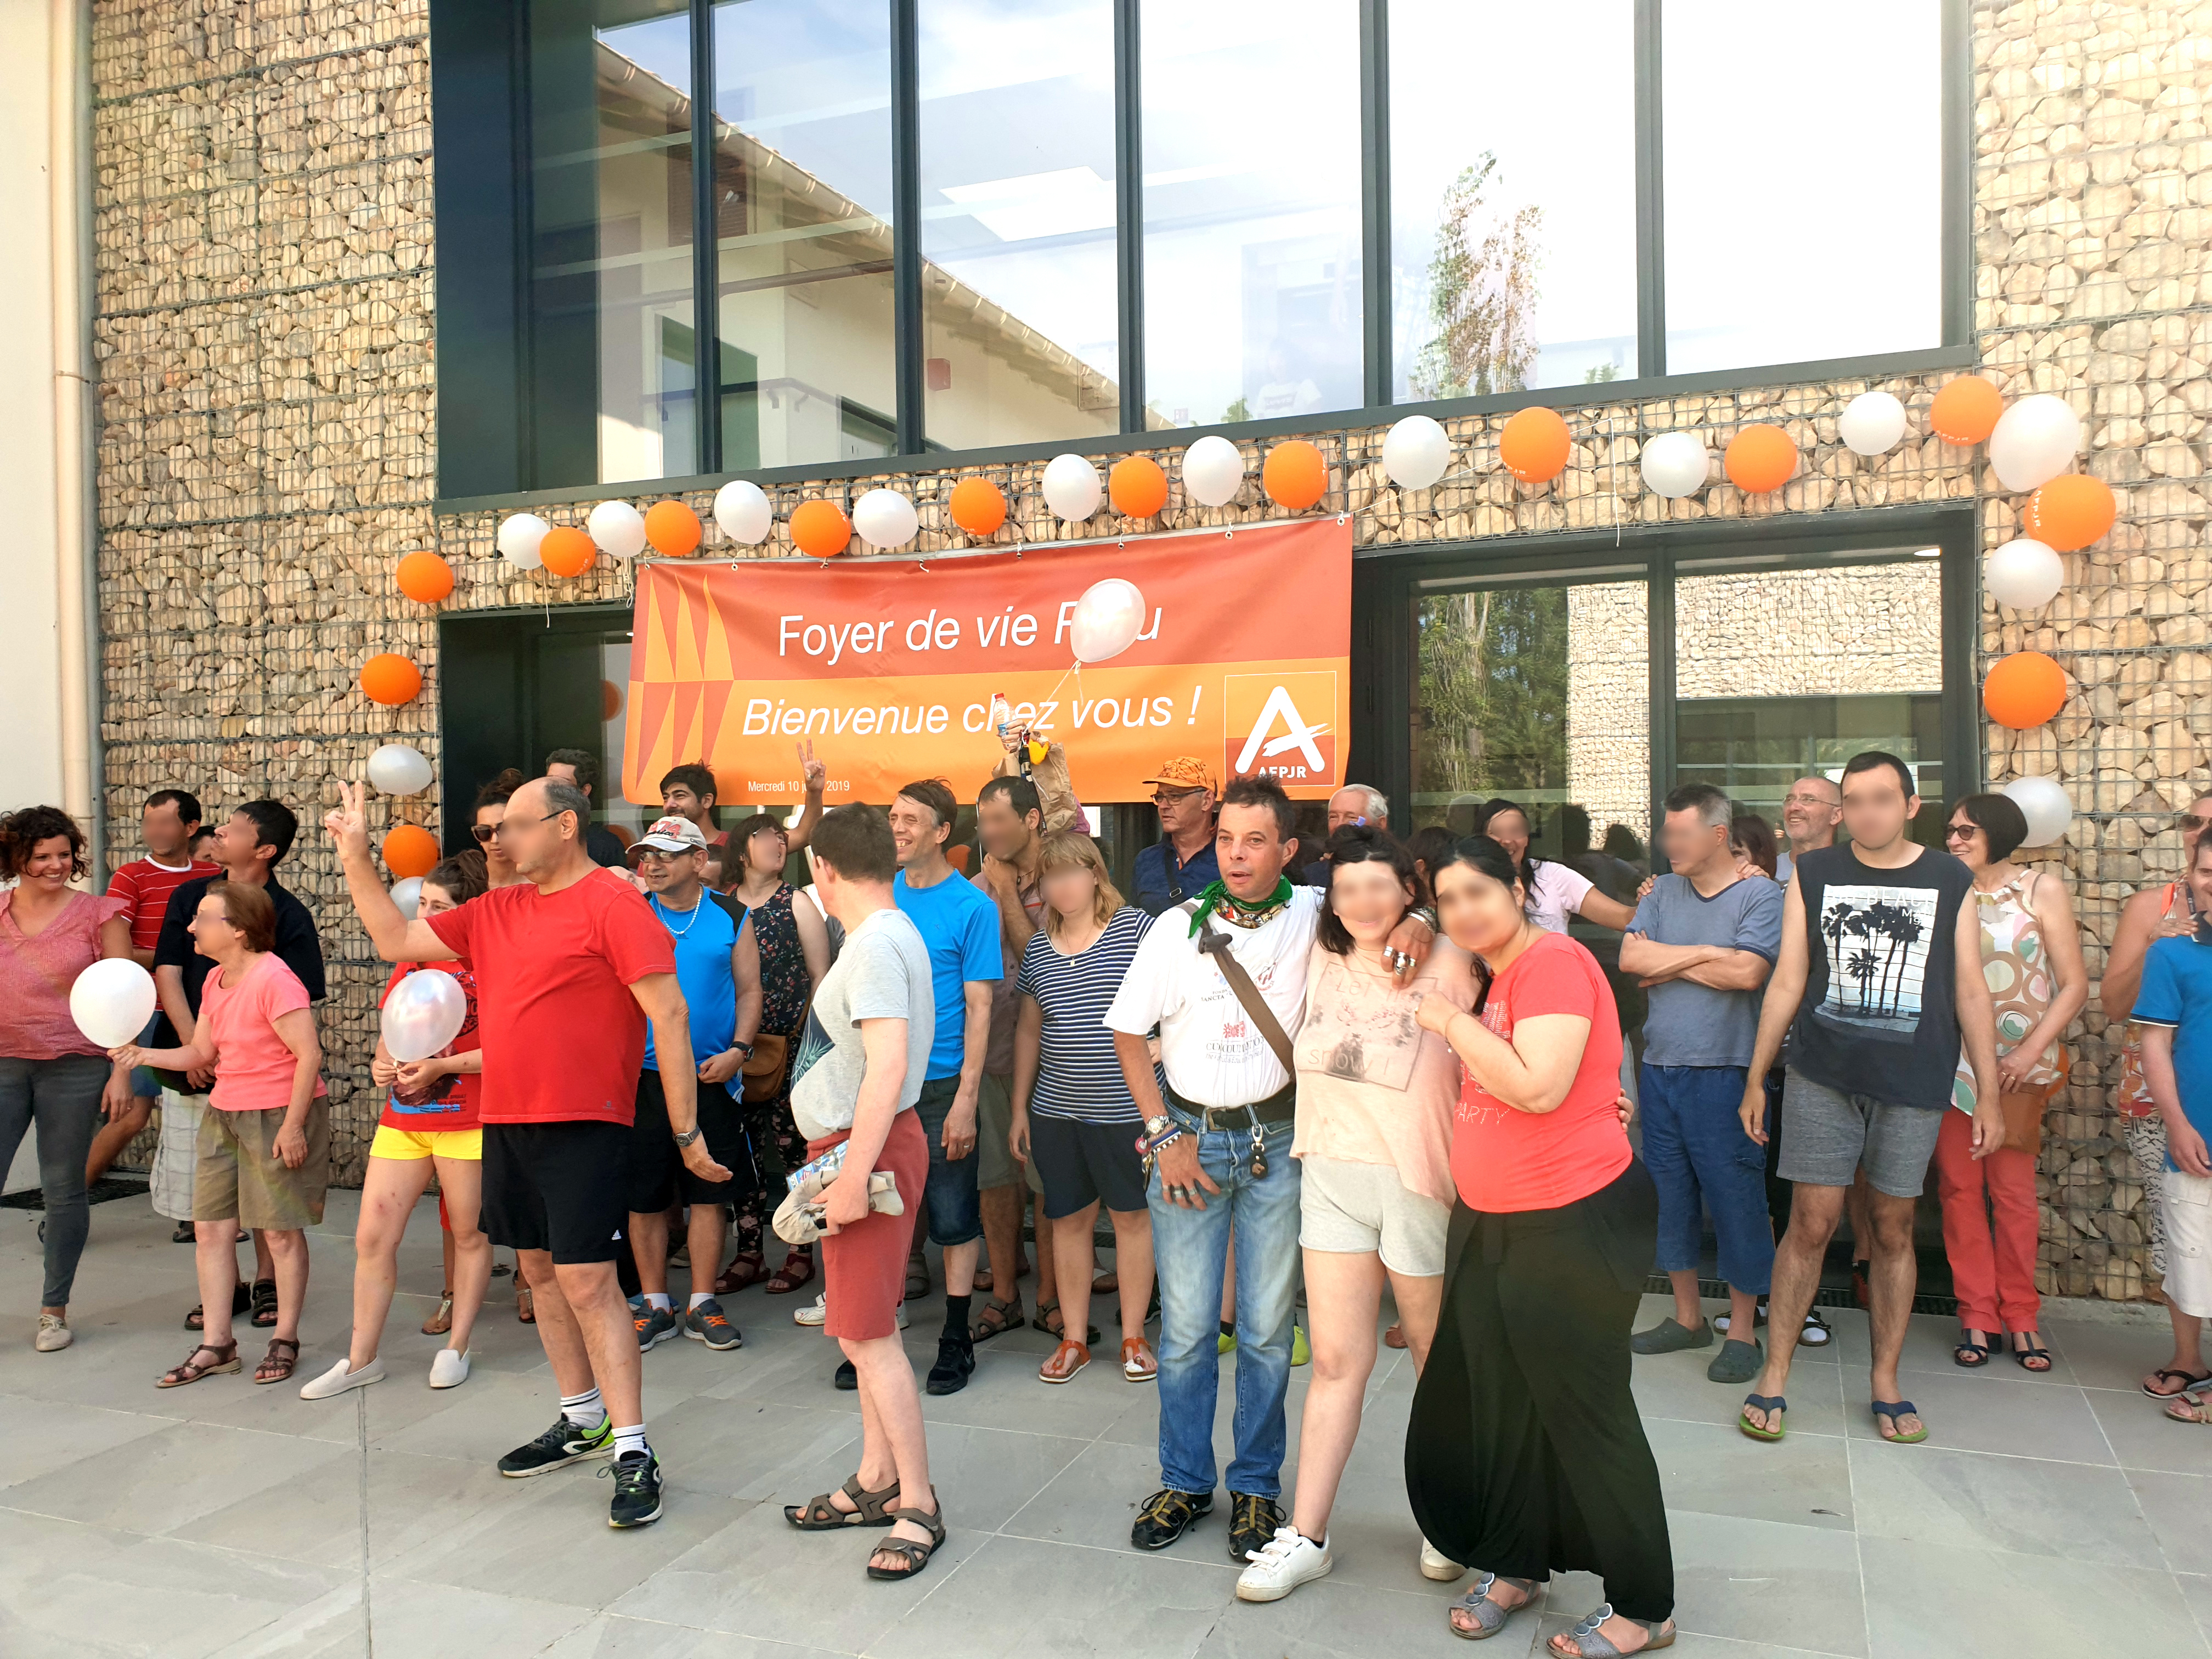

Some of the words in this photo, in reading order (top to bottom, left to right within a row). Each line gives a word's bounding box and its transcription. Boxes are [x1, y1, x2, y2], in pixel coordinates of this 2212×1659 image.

[779, 615, 894, 665] Foyer
[906, 609, 960, 651] de
[977, 606, 1038, 647] vie
[742, 698, 949, 735] Bienvenue
[1072, 696, 1173, 729] vous
[1187, 685, 1202, 725] !
[748, 780, 785, 792] Mercredi
[788, 781, 799, 792] 10
[826, 780, 850, 792] 2019
